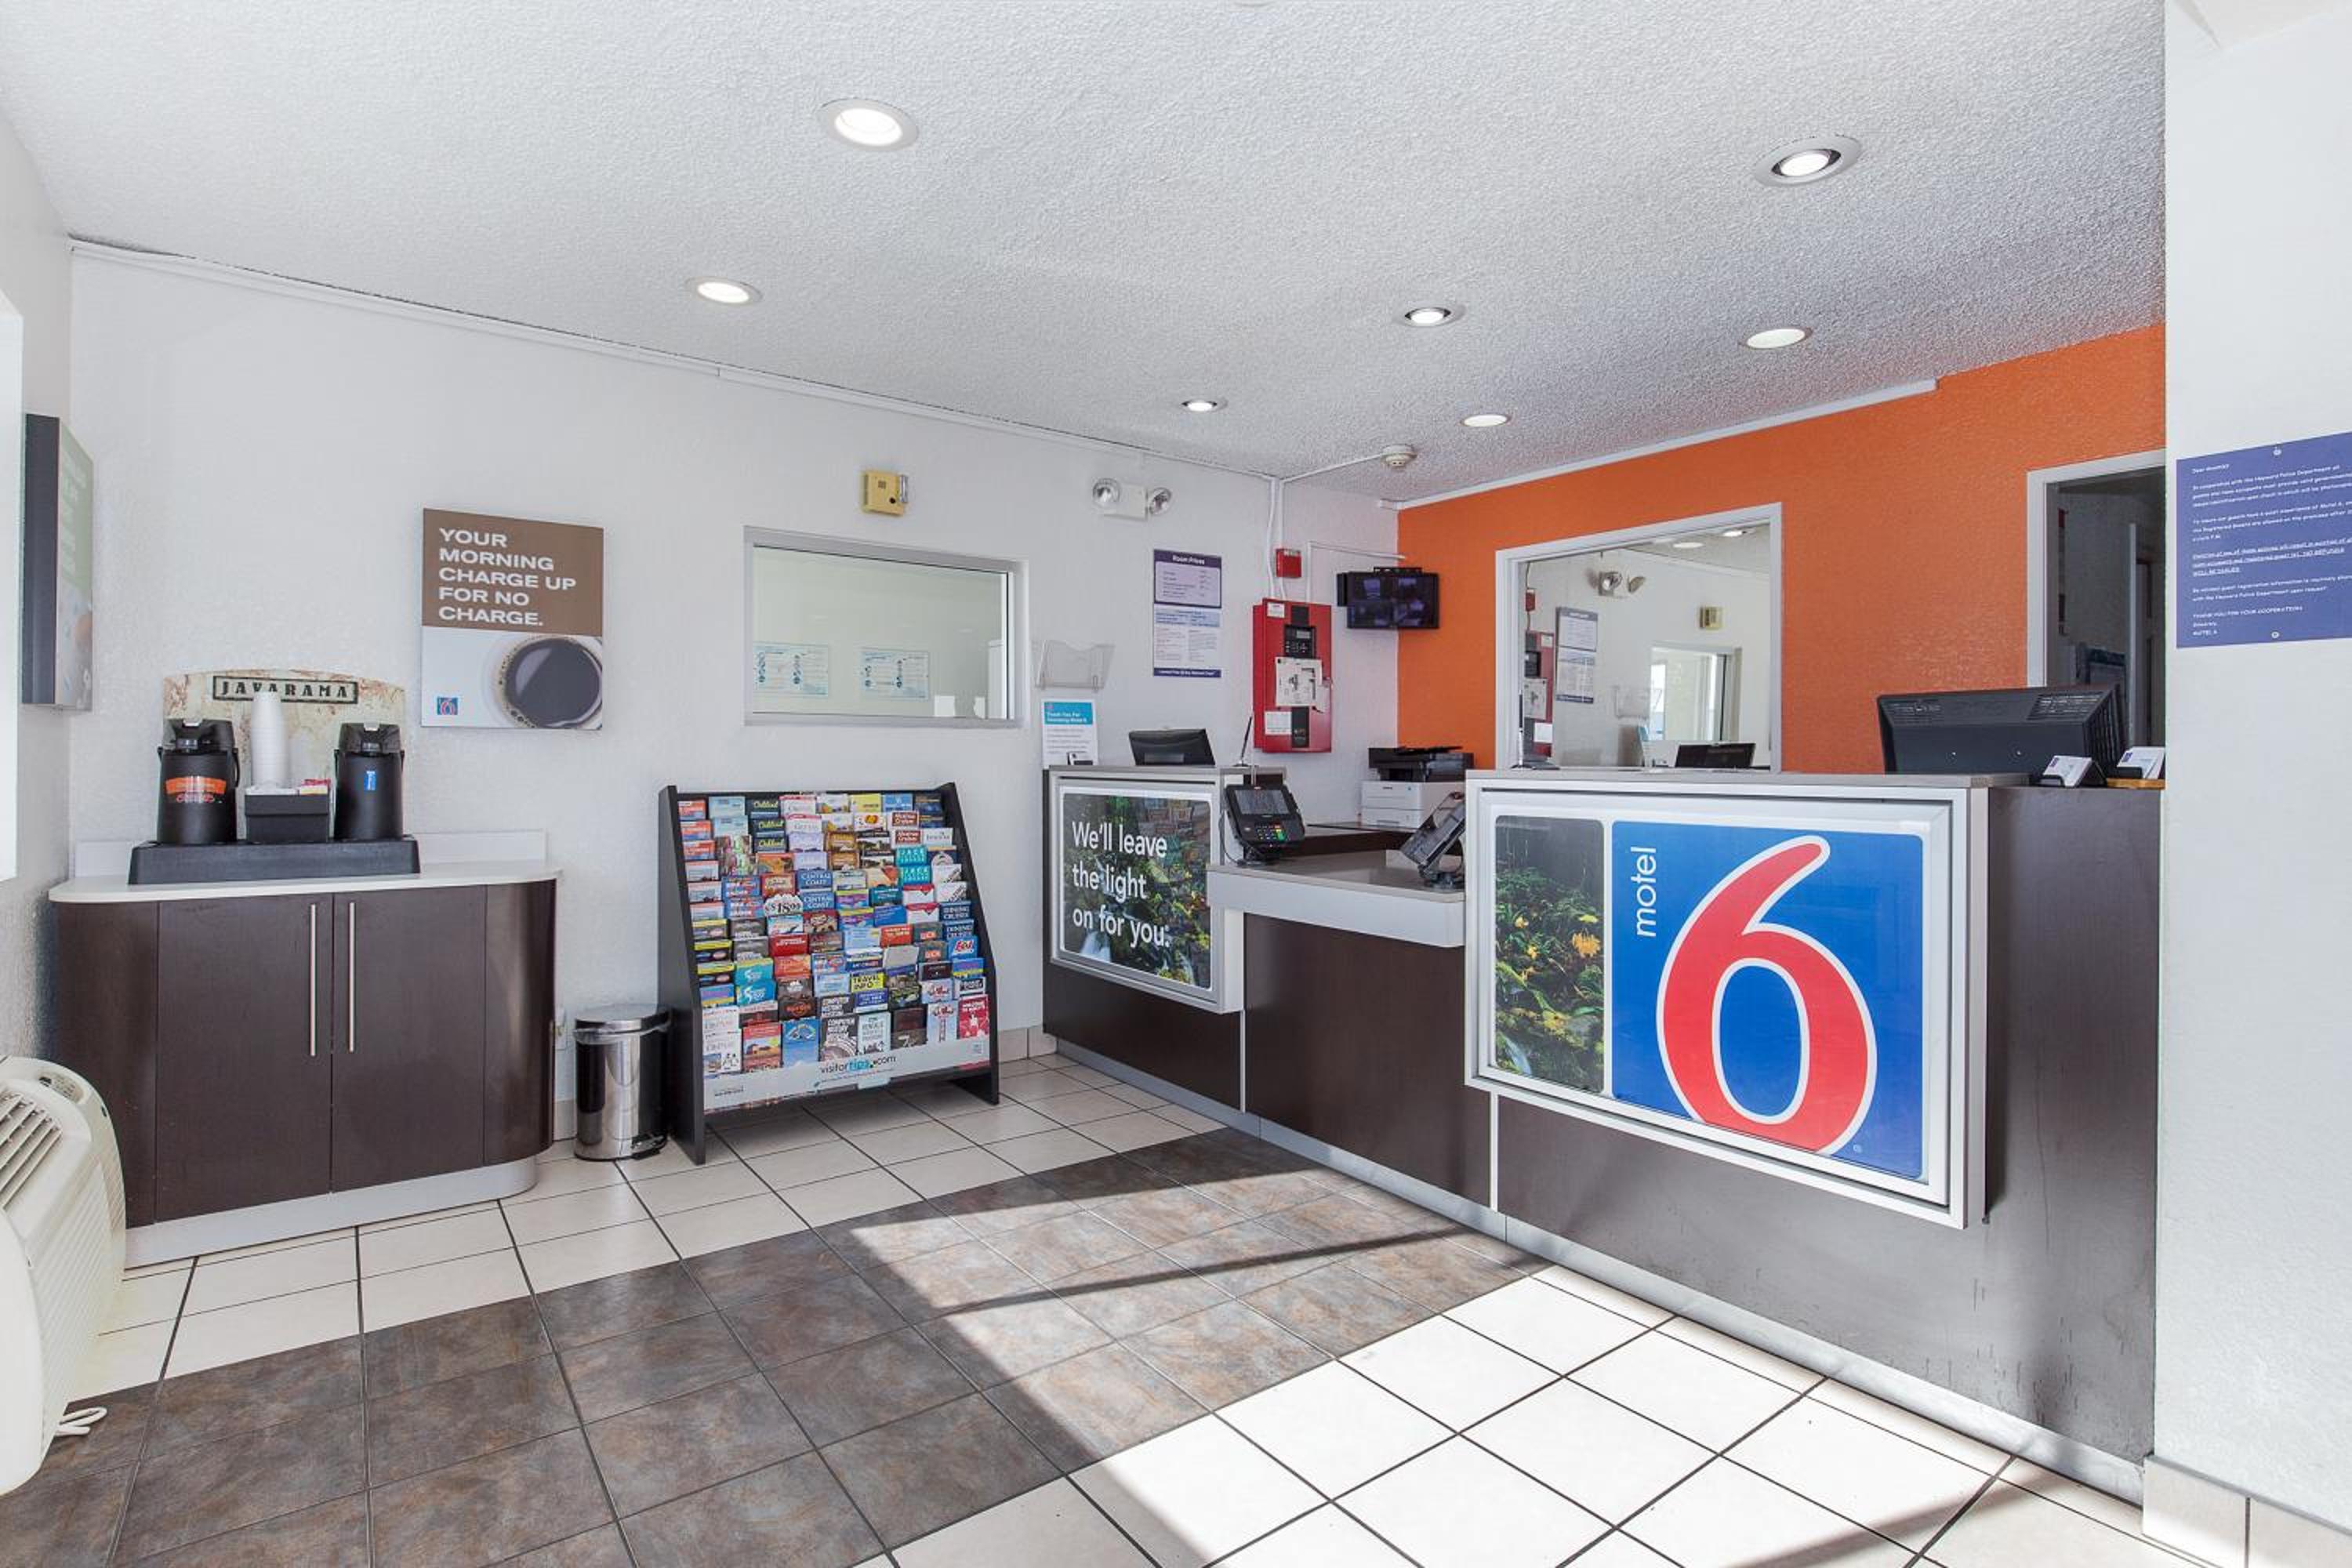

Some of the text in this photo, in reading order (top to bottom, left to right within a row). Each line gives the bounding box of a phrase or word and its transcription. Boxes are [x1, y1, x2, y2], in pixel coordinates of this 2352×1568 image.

[439, 527, 508, 548] YOUR
[439, 547, 554, 571] MORNING
[438, 567, 577, 590] CHARGE UP
[438, 586, 530, 606] FOR NO
[438, 606, 544, 626] CHARGE.
[220, 681, 348, 699] JAVARAMA
[1072, 821, 1168, 858] We'll leave
[1072, 861, 1149, 903] the light
[1630, 846, 1657, 938] motel
[1073, 907, 1094, 929] on
[1098, 904, 1125, 937] for
[1656, 834, 1878, 1157] 6
